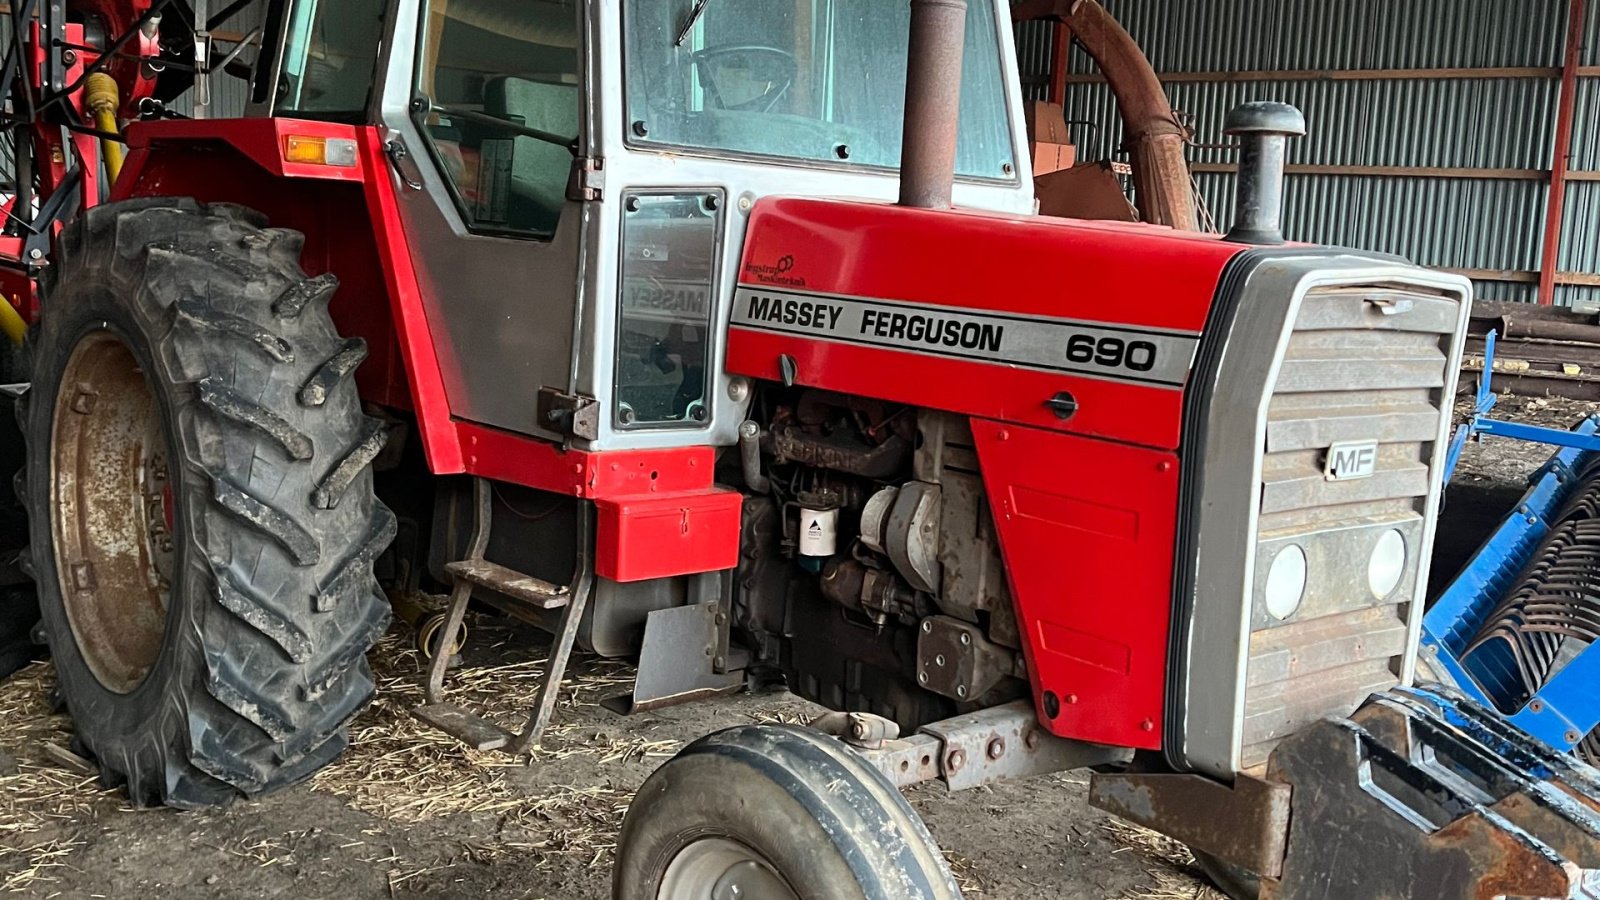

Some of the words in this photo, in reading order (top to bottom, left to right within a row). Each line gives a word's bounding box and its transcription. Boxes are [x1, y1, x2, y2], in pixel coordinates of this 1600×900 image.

[748, 296, 843, 330] MASSEY
[859, 310, 1004, 352] FERGUSON
[1067, 334, 1157, 372] 690
[1335, 448, 1373, 474] MF
